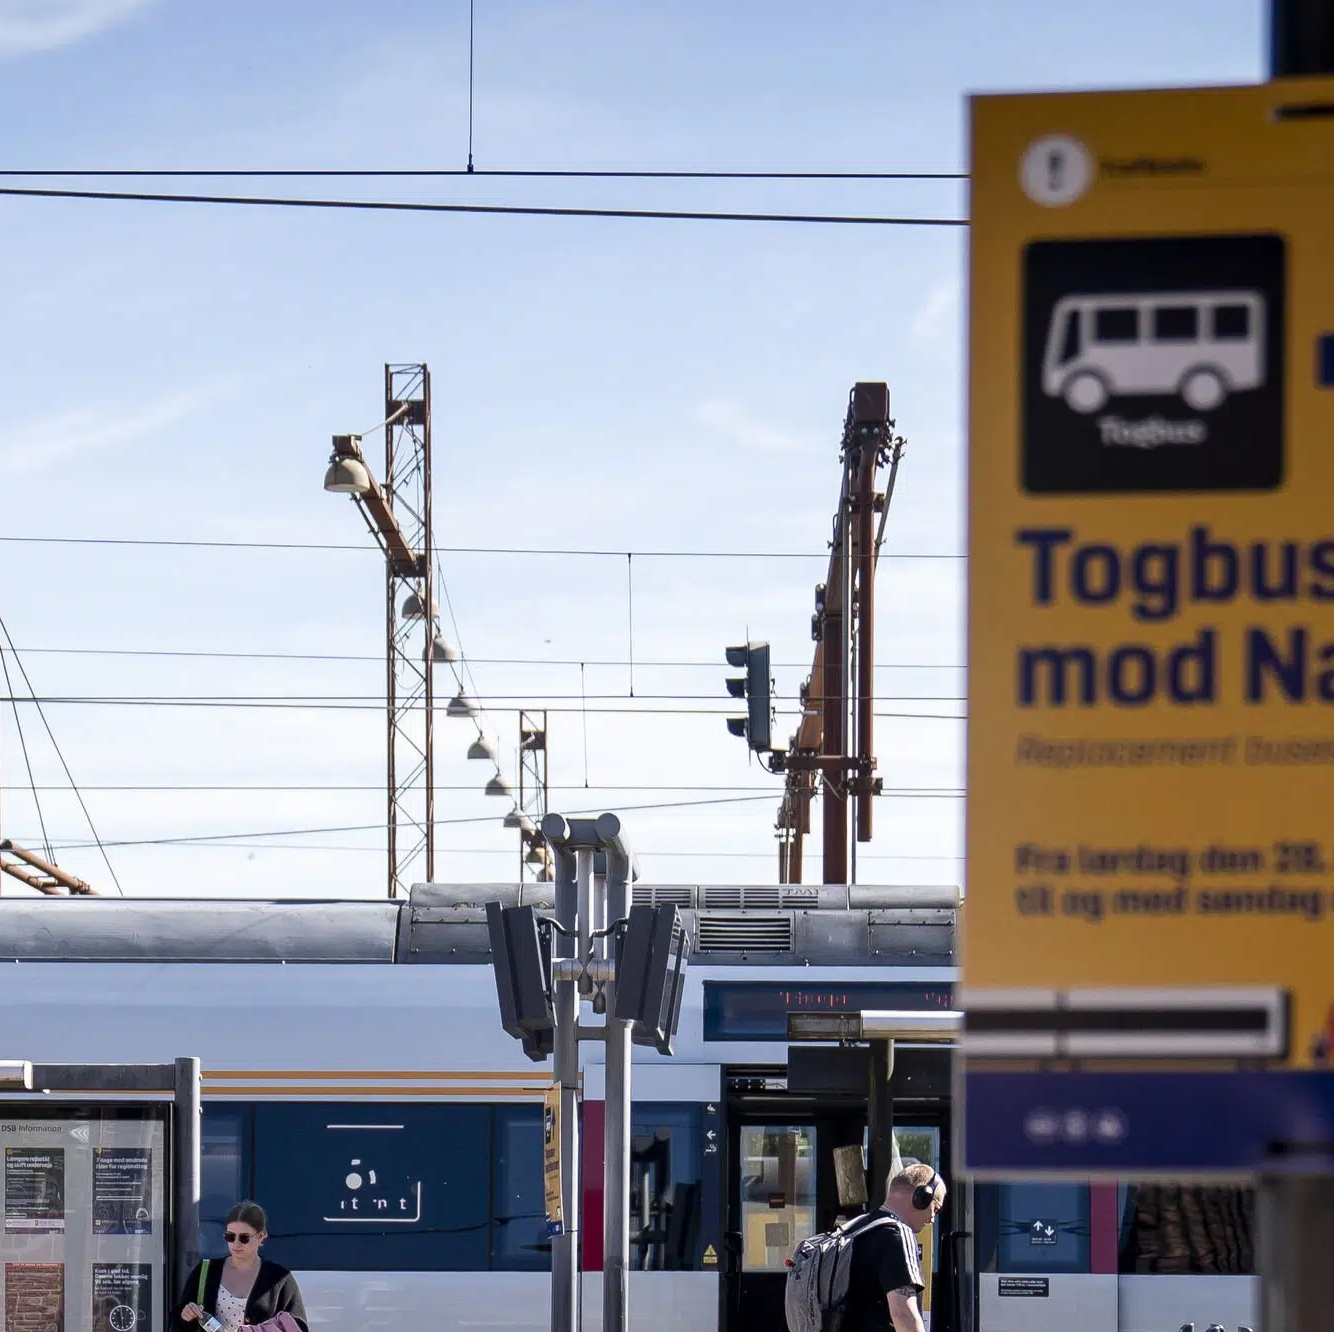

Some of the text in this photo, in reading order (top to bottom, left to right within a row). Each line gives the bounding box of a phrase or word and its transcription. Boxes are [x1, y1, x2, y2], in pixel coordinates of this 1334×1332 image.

[1016, 627, 1218, 708] mod
[1015, 845, 1071, 873] Fra
[1200, 846, 1264, 873] den
[1063, 893, 1105, 922] og
[1113, 885, 1186, 915] med
[1, 1124, 62, 1132] DSB Information
